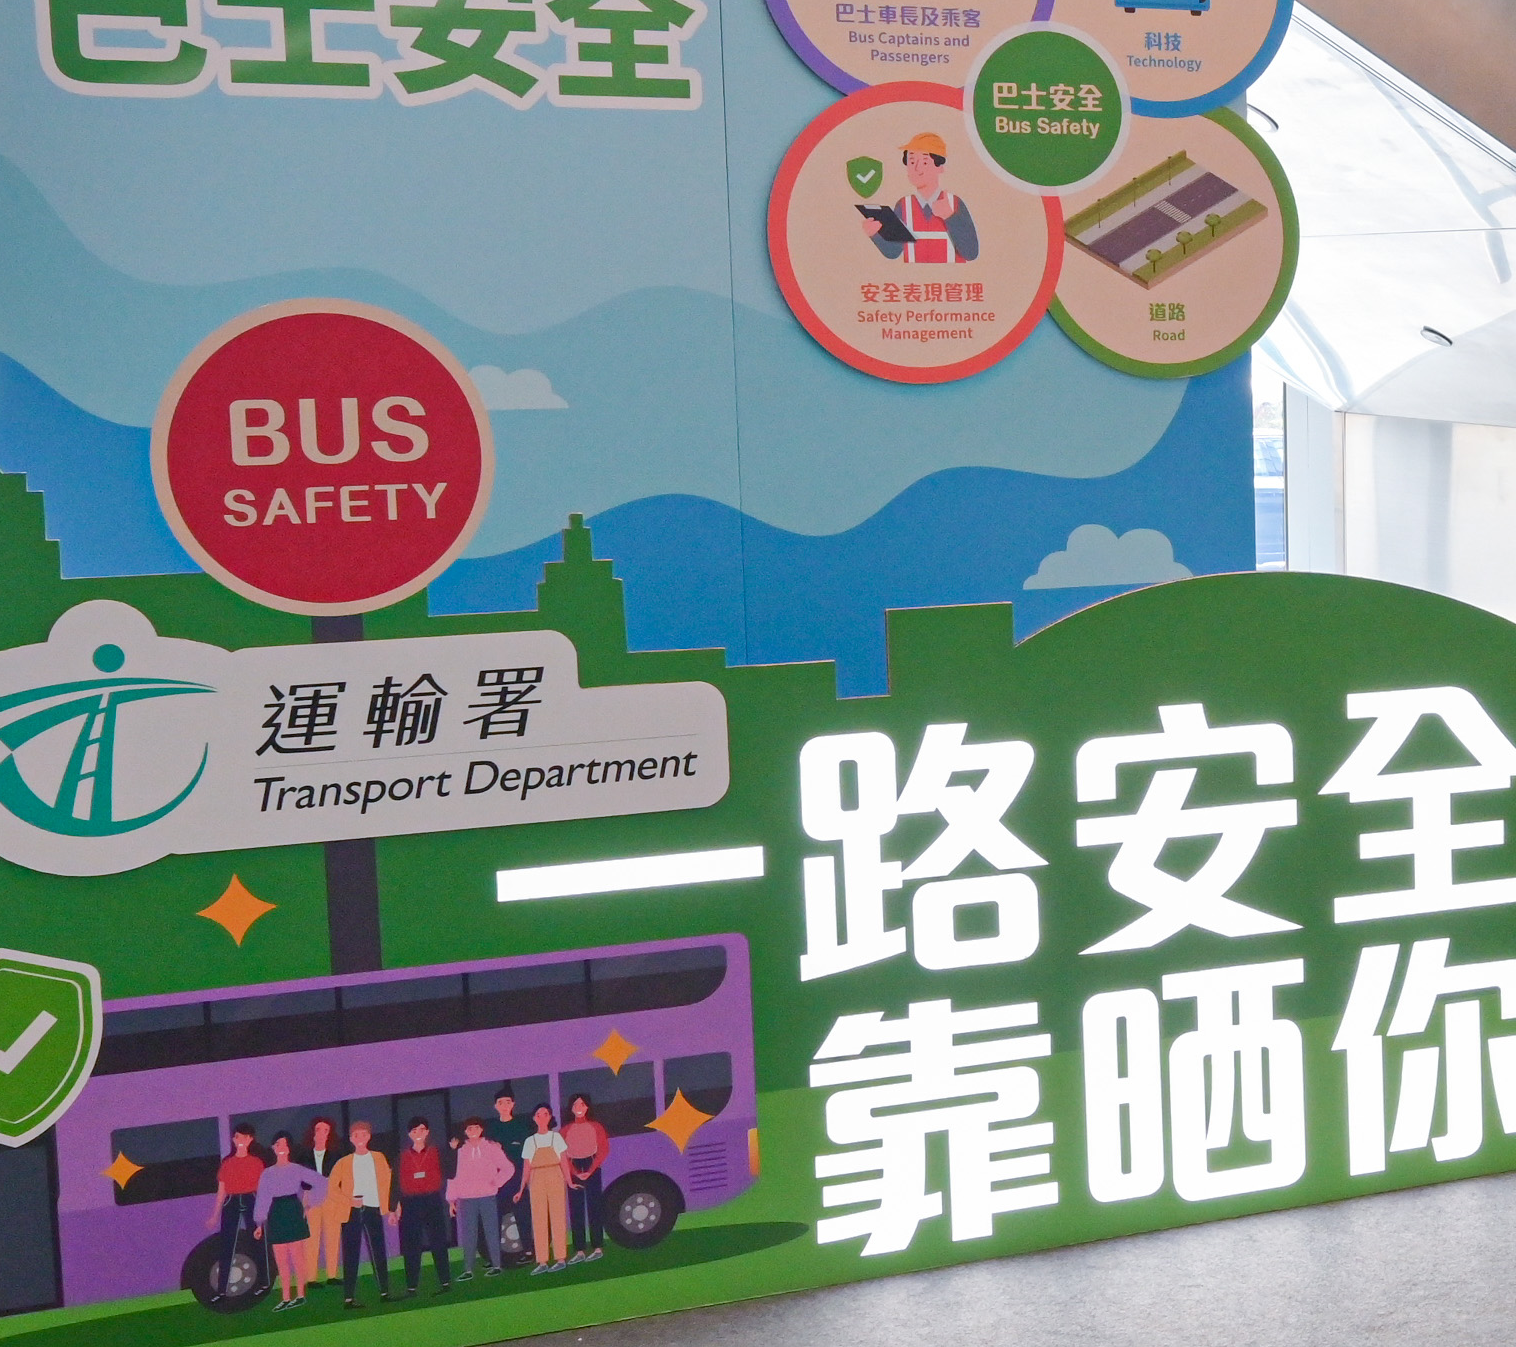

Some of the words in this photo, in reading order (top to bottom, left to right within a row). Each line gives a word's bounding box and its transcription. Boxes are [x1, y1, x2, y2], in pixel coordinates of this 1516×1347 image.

[836, 4, 980, 29] 巴士車長及乘客
[848, 31, 875, 45] Bus
[879, 31, 939, 48] Captains
[944, 34, 970, 47] and
[1144, 32, 1182, 51] 科技
[871, 49, 950, 66] Passengers
[1127, 55, 1202, 72] Technology
[992, 82, 1102, 112] 巴士安全
[995, 117, 1031, 133] Bus
[1037, 117, 1100, 139] Safety
[860, 283, 984, 303] 安全表現管理
[857, 309, 902, 324] Safety
[906, 309, 995, 323] Performance
[1148, 303, 1186, 322] 道路
[881, 327, 973, 341] Management
[1153, 329, 1185, 341] Road
[230, 396, 429, 466] BUS
[222, 482, 447, 527] SAFETY
[255, 665, 544, 757] 運輸署
[255, 768, 452, 816] Transport
[465, 749, 698, 804] Department
